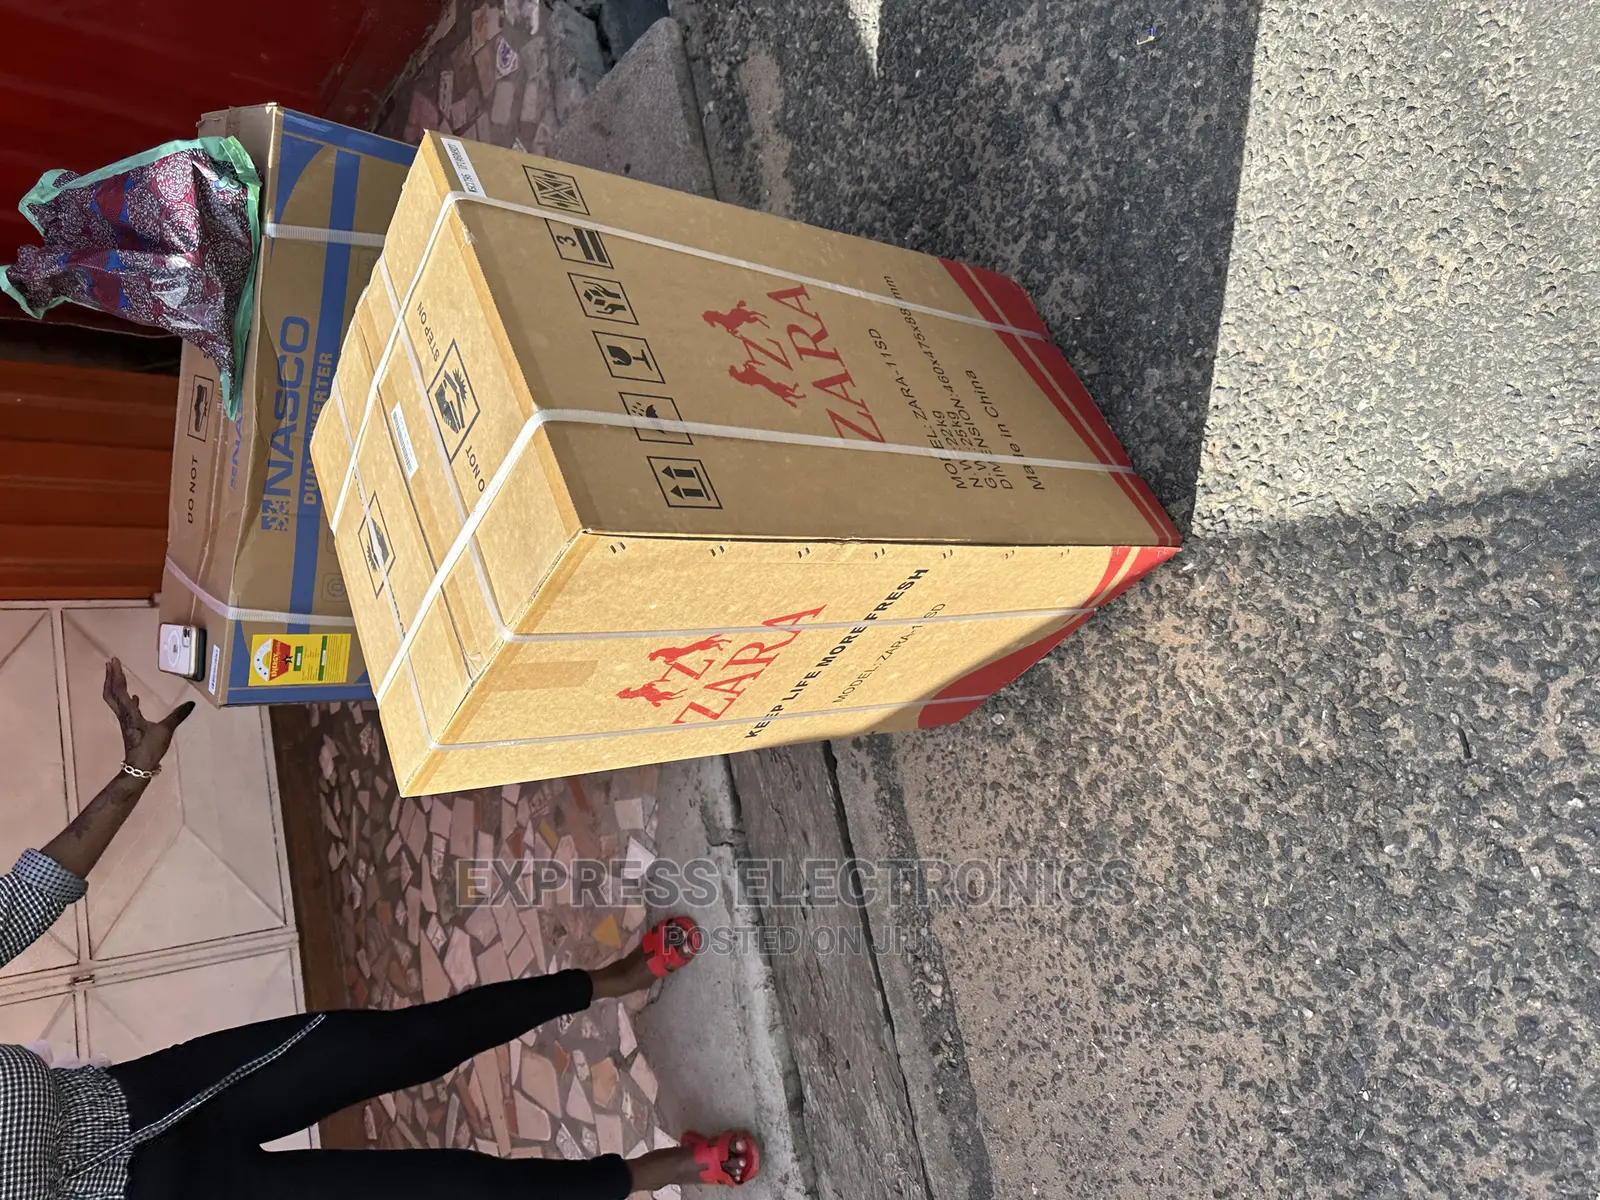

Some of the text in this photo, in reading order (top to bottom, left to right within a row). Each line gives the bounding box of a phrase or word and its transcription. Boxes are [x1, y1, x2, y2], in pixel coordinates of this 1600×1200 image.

[556, 235, 577, 248] 3
[417, 302, 440, 361] STEP ON
[766, 284, 885, 443] ZARA
[265, 316, 310, 497] NASCO
[868, 328, 927, 421] ZARA-11SD
[965, 370, 999, 418] China
[465, 445, 481, 479] NOT
[997, 424, 1012, 438] in
[187, 455, 198, 524] DO NOT
[672, 604, 828, 724] ZARA
[781, 670, 822, 702] LIFE
[818, 625, 867, 667] MORE
[863, 568, 929, 622] FRESH
[833, 603, 946, 704] MODEL: ZARA-1SD
